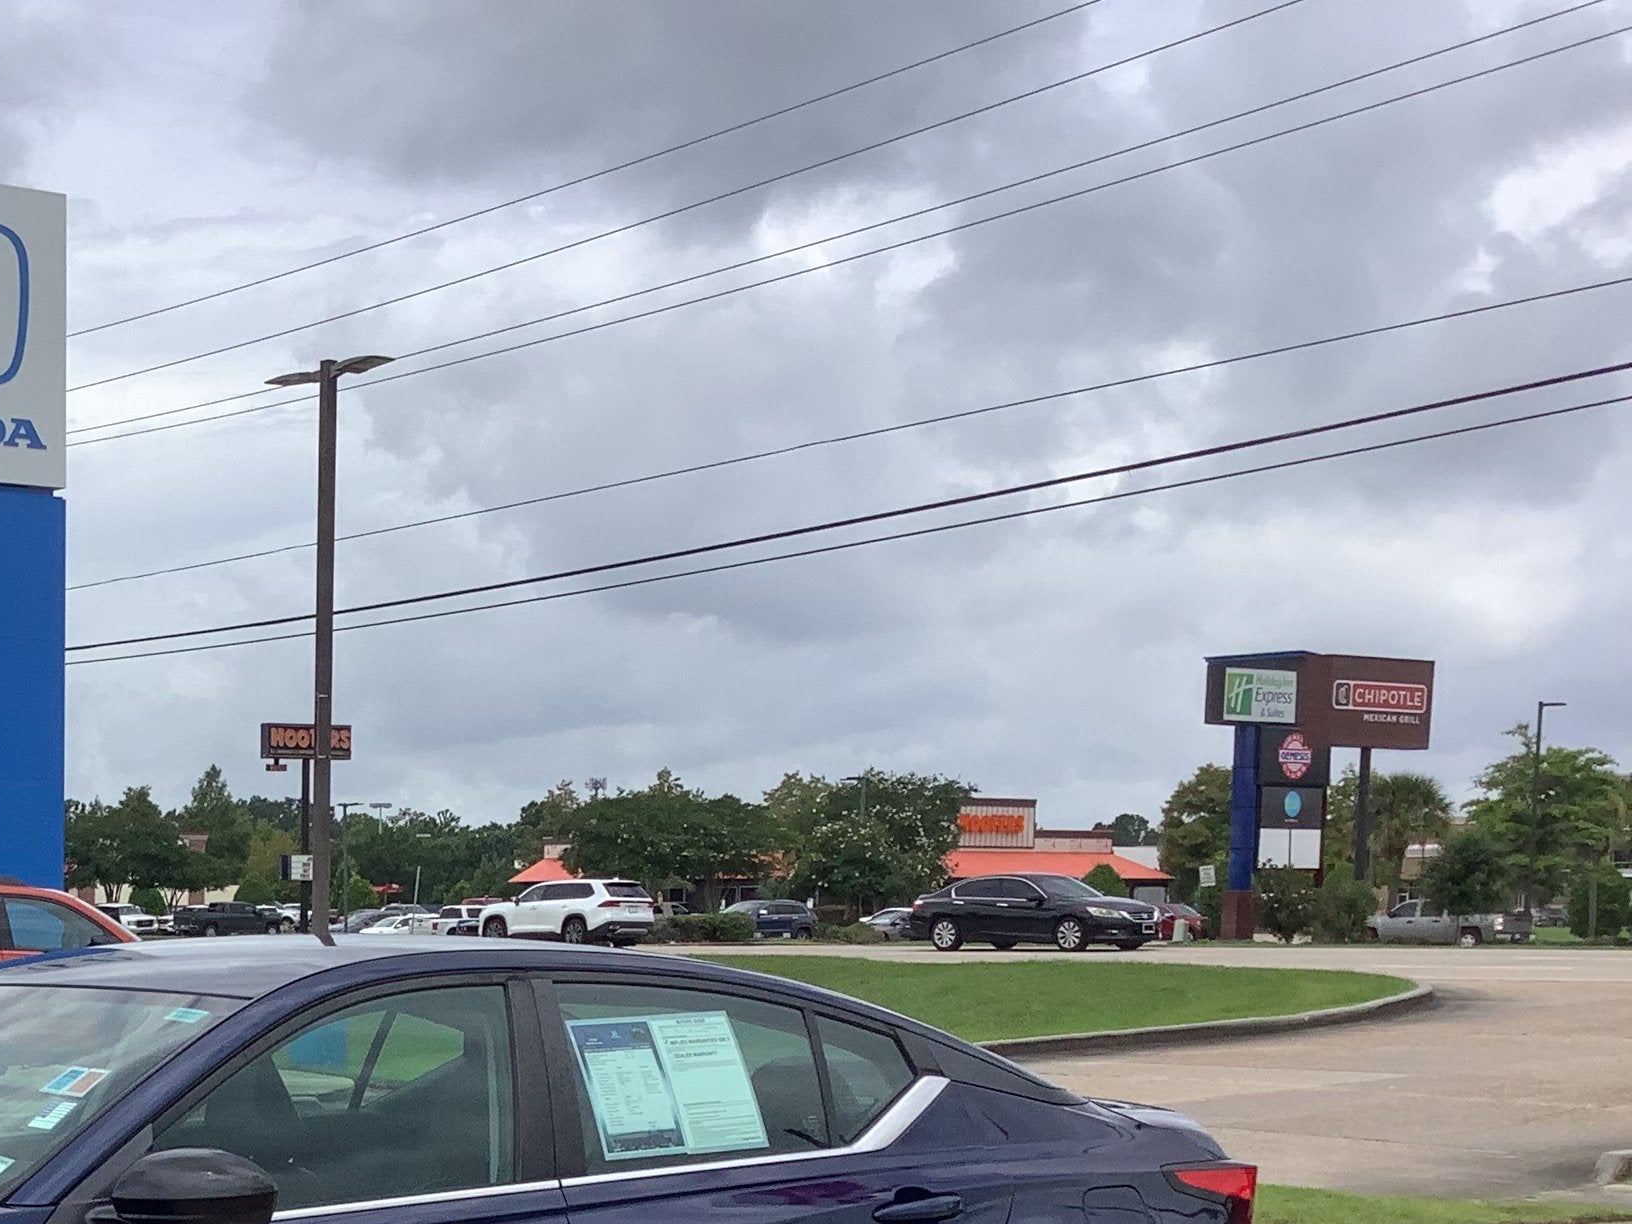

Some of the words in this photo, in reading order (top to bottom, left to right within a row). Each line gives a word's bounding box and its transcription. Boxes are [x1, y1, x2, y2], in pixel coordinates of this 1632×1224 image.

[1255, 687, 1294, 706] Express
[1354, 688, 1423, 707] CHIPOTLE
[1363, 713, 1397, 723] MEXICAN
[1398, 715, 1421, 725] GRILL
